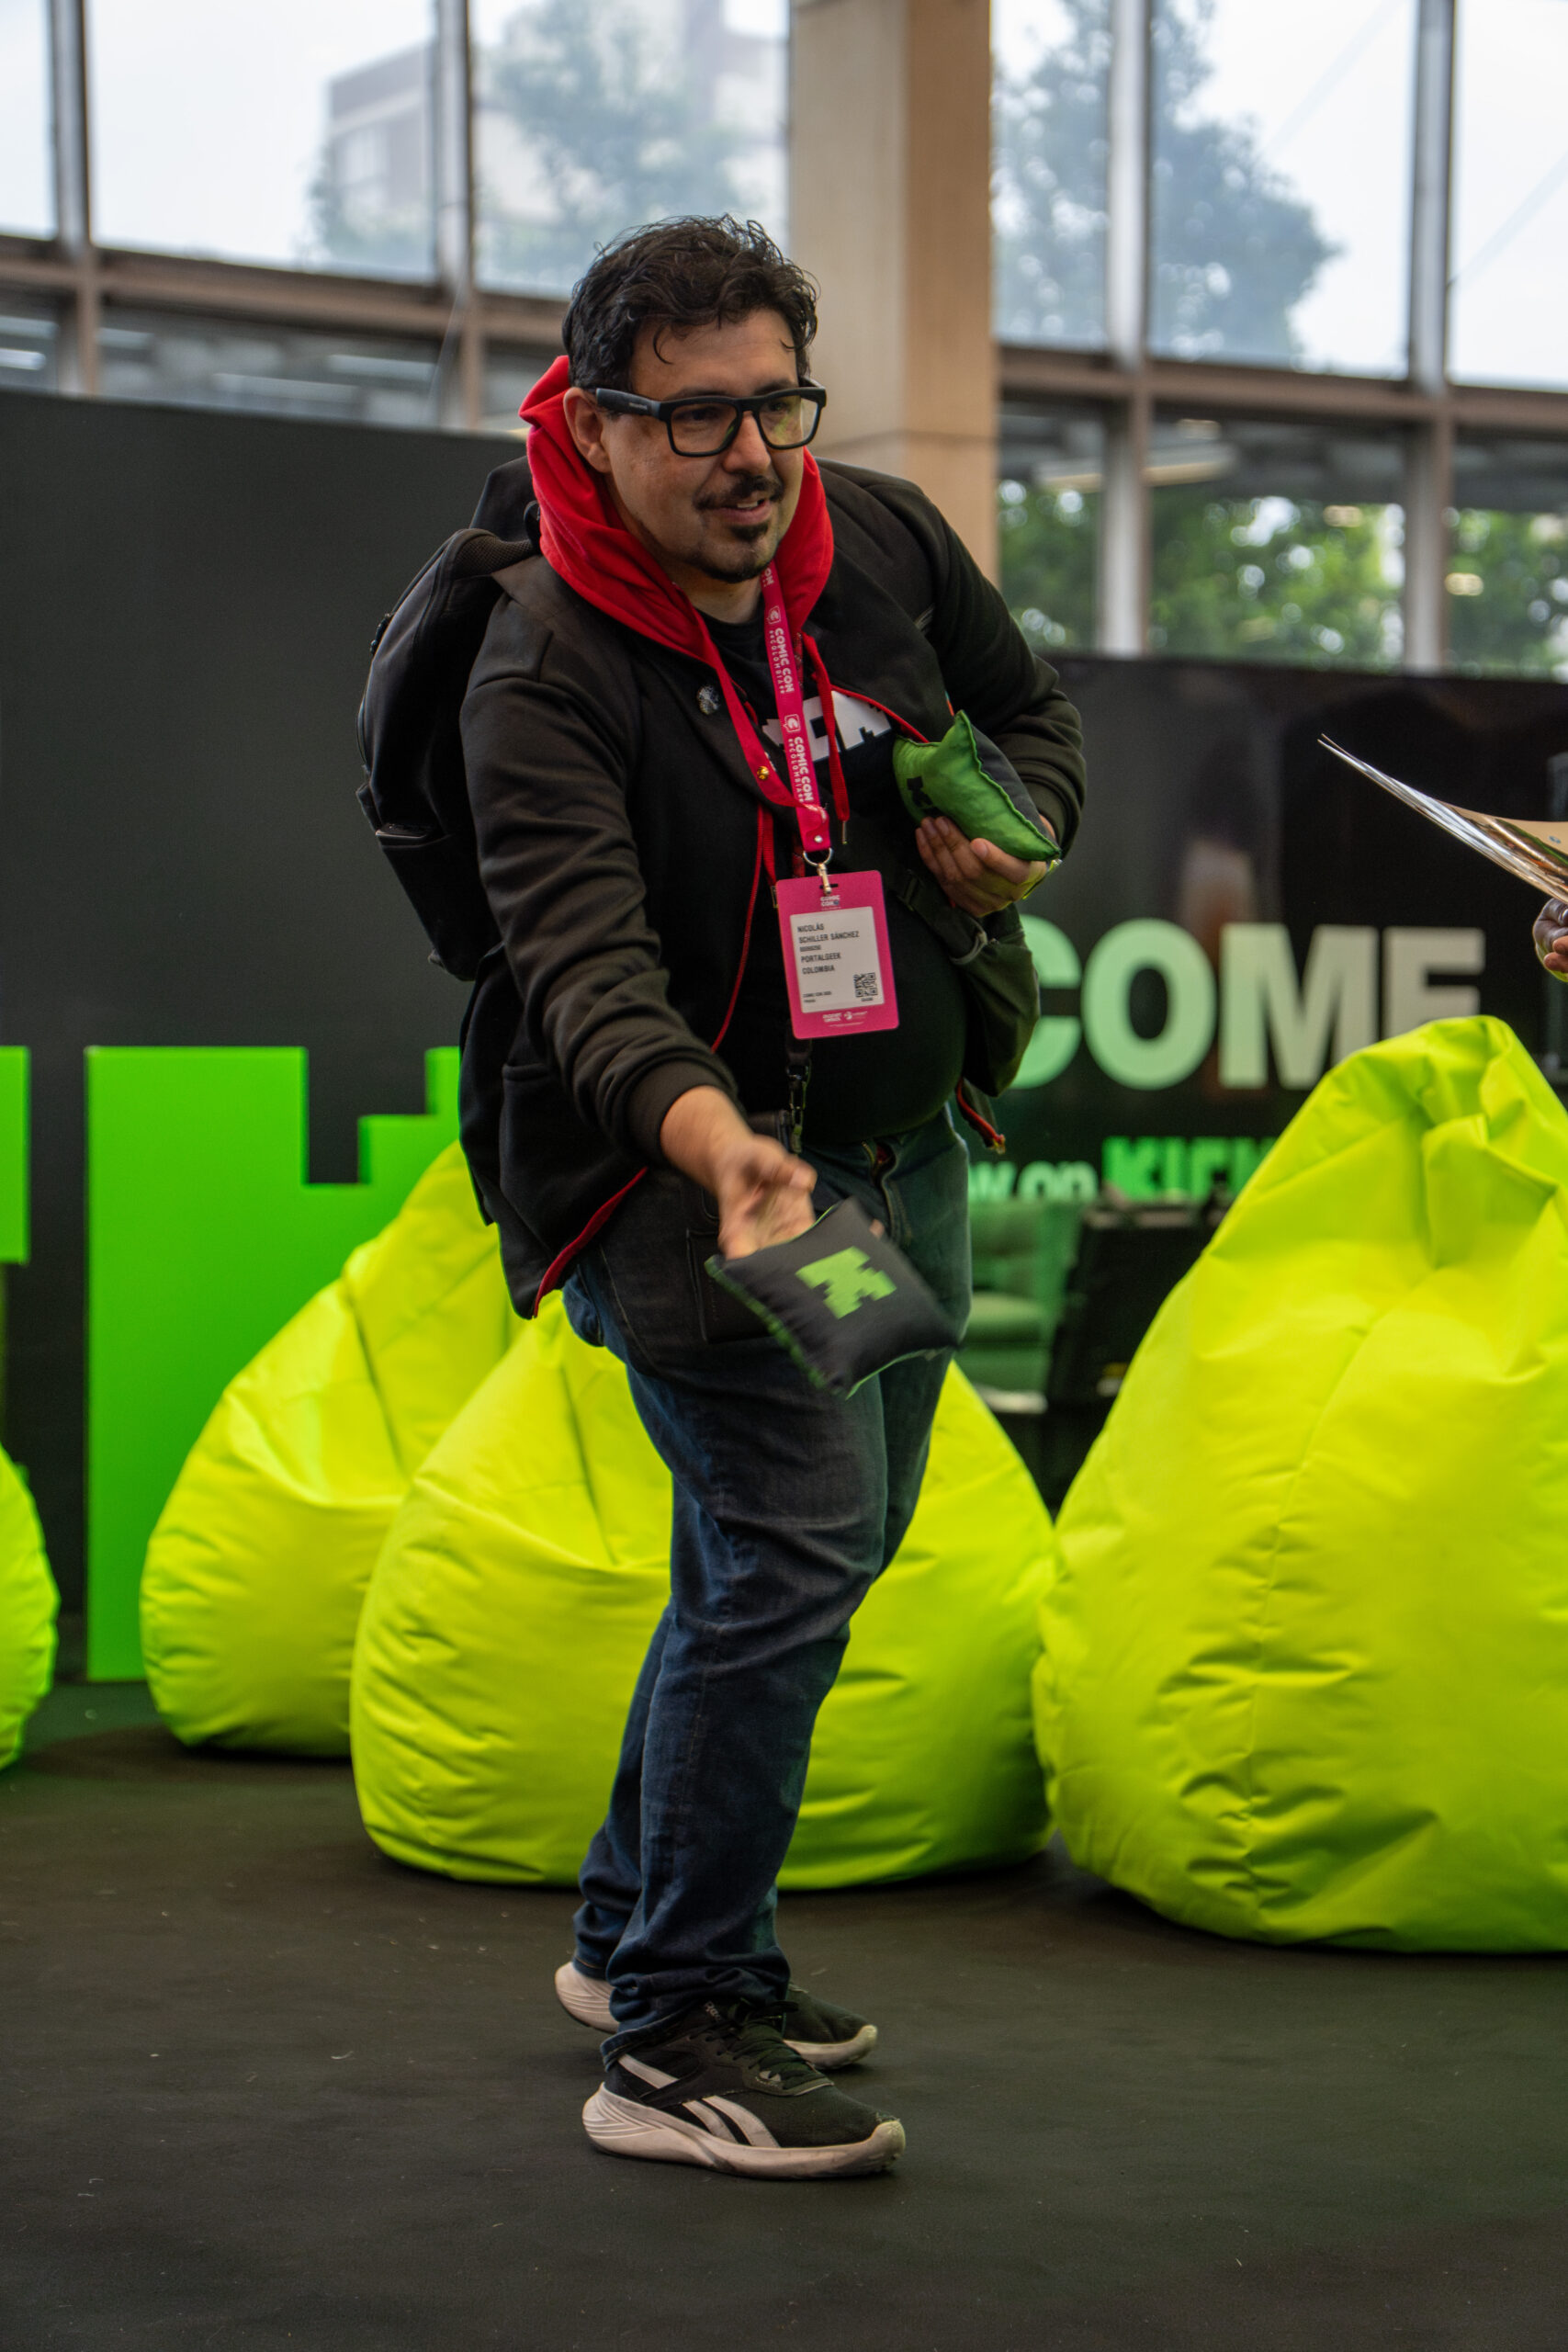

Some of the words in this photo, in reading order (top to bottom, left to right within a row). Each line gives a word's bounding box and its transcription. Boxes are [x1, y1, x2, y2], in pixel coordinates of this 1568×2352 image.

[774, 628, 790, 666] COMIC
[782, 667, 795, 693] CON
[794, 736, 809, 775] COMIC
[801, 775, 814, 802] CON
[802, 964, 836, 975] COLOMBIA
